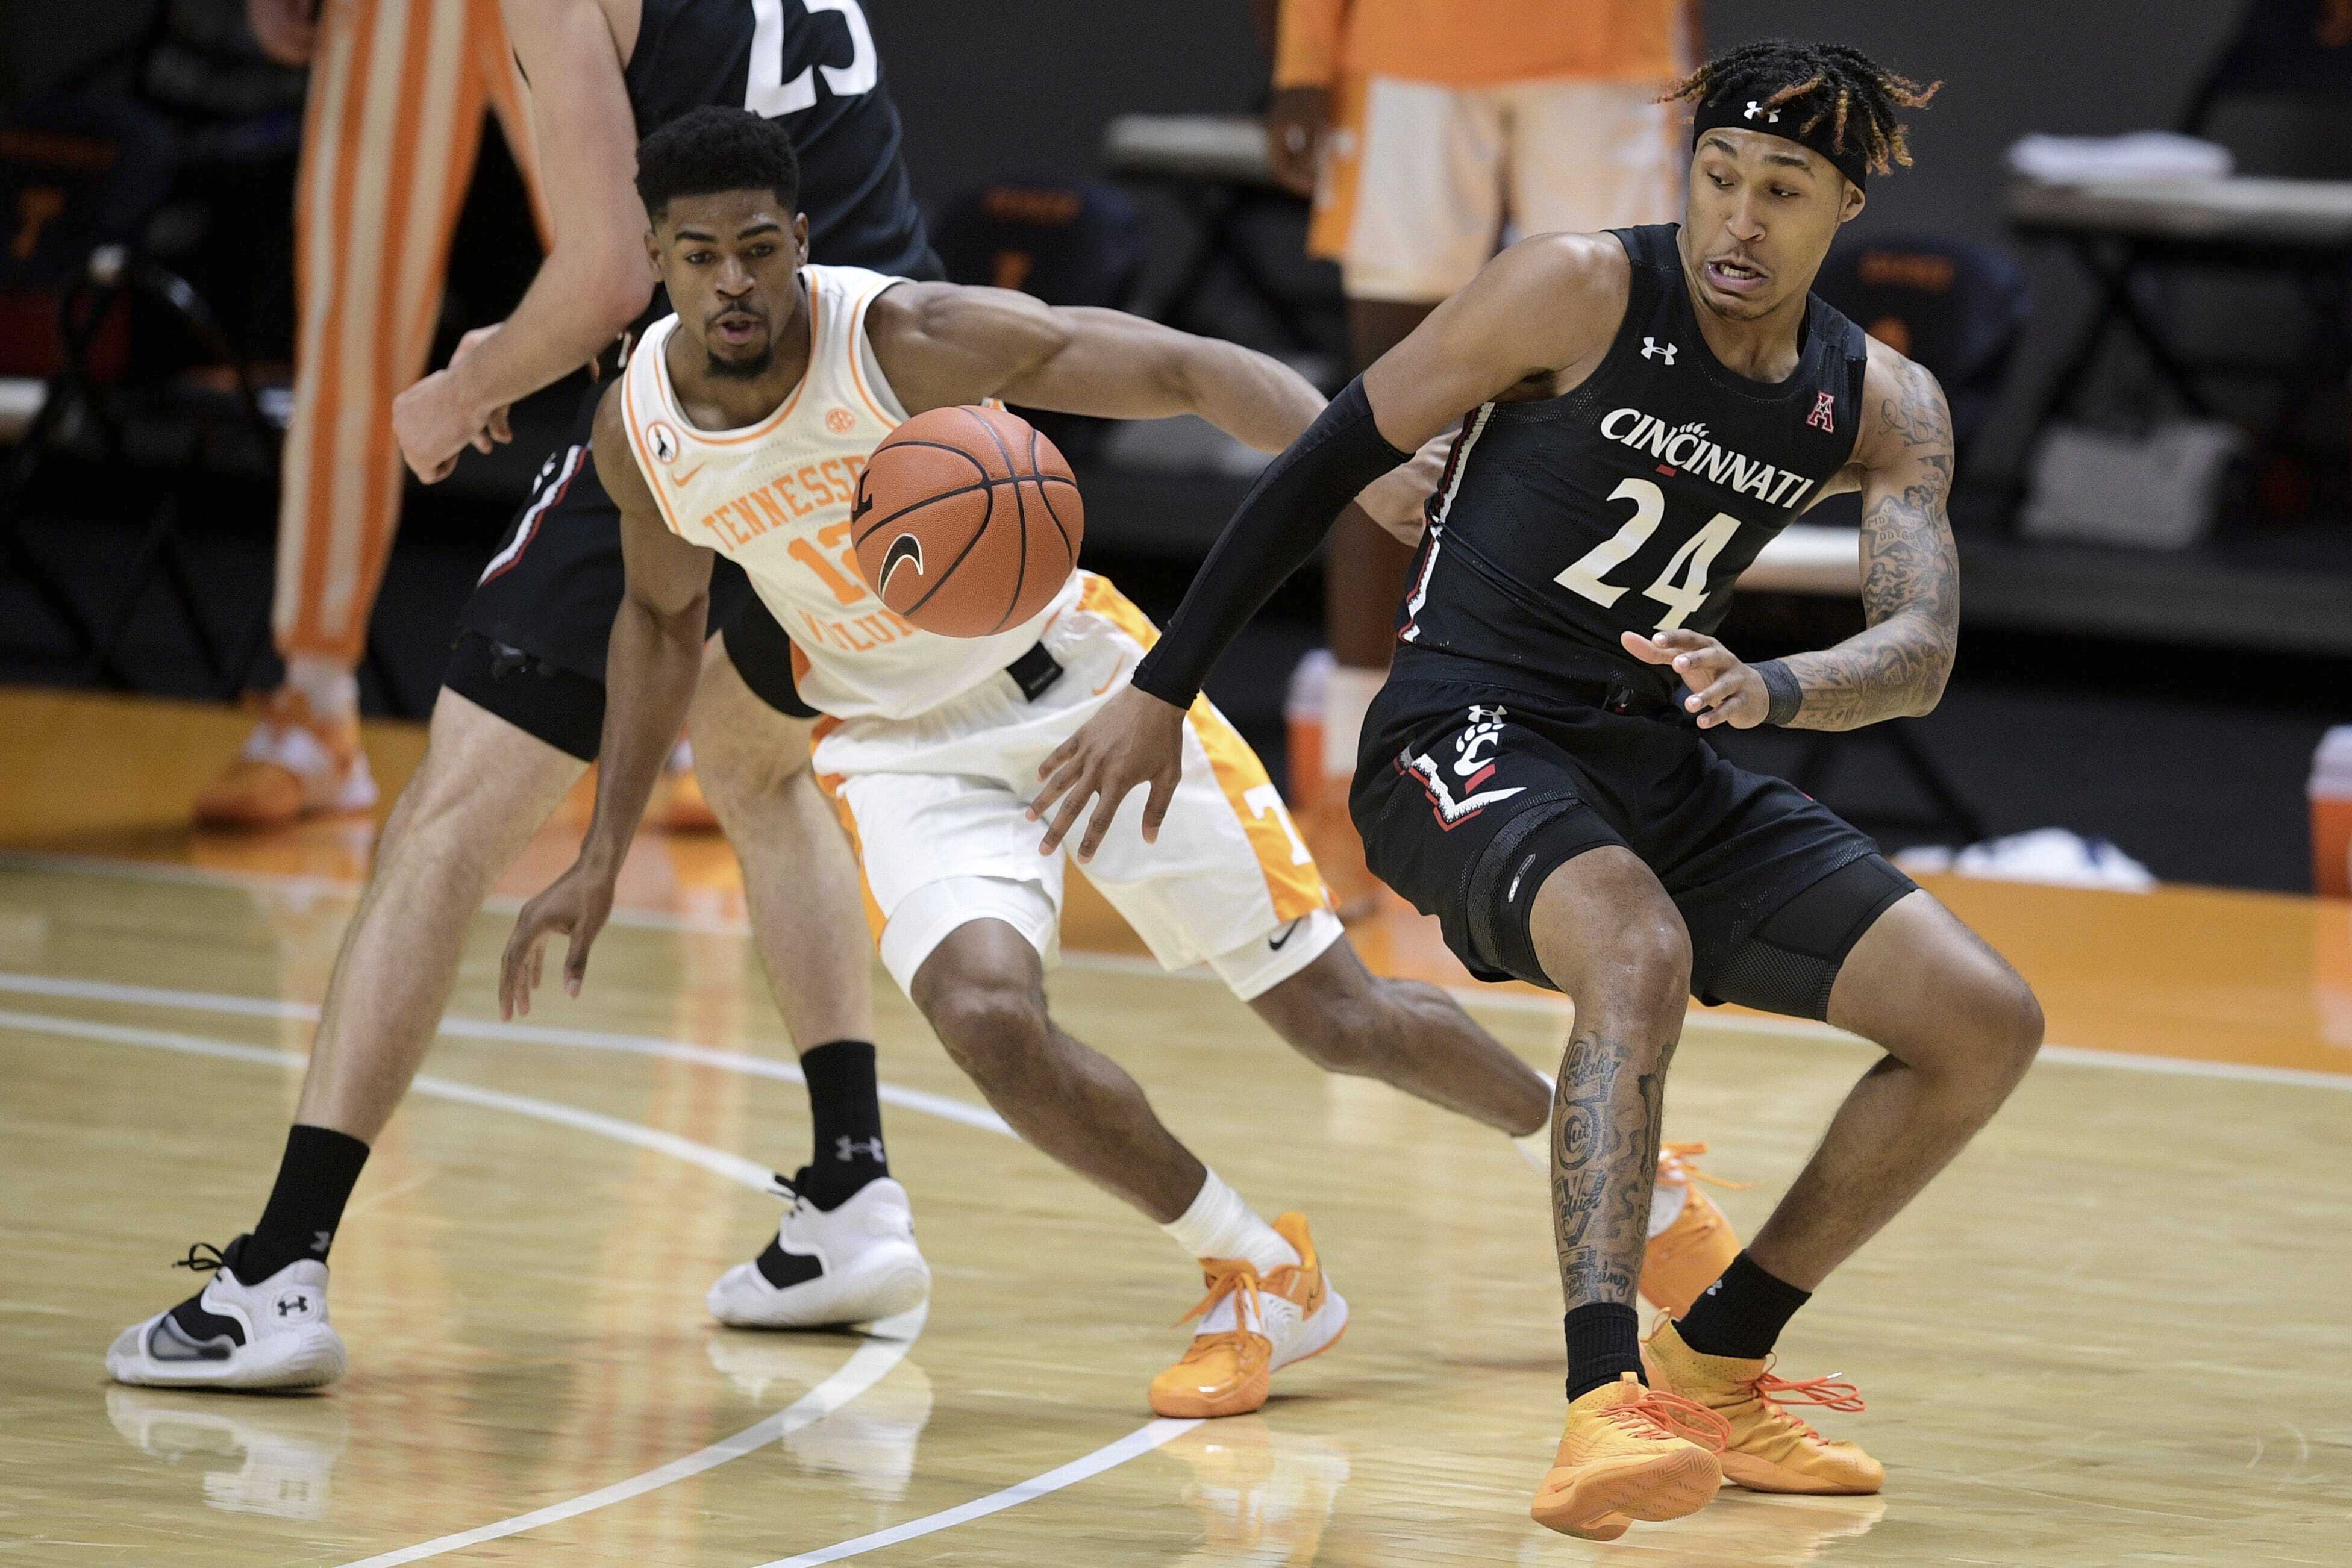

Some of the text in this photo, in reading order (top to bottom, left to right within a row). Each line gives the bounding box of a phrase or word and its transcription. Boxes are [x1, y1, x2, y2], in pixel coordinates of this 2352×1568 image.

[702, 455, 866, 551] TENNESS
[1600, 408, 1815, 508] CINCINNATI
[1553, 478, 1742, 631] 24
